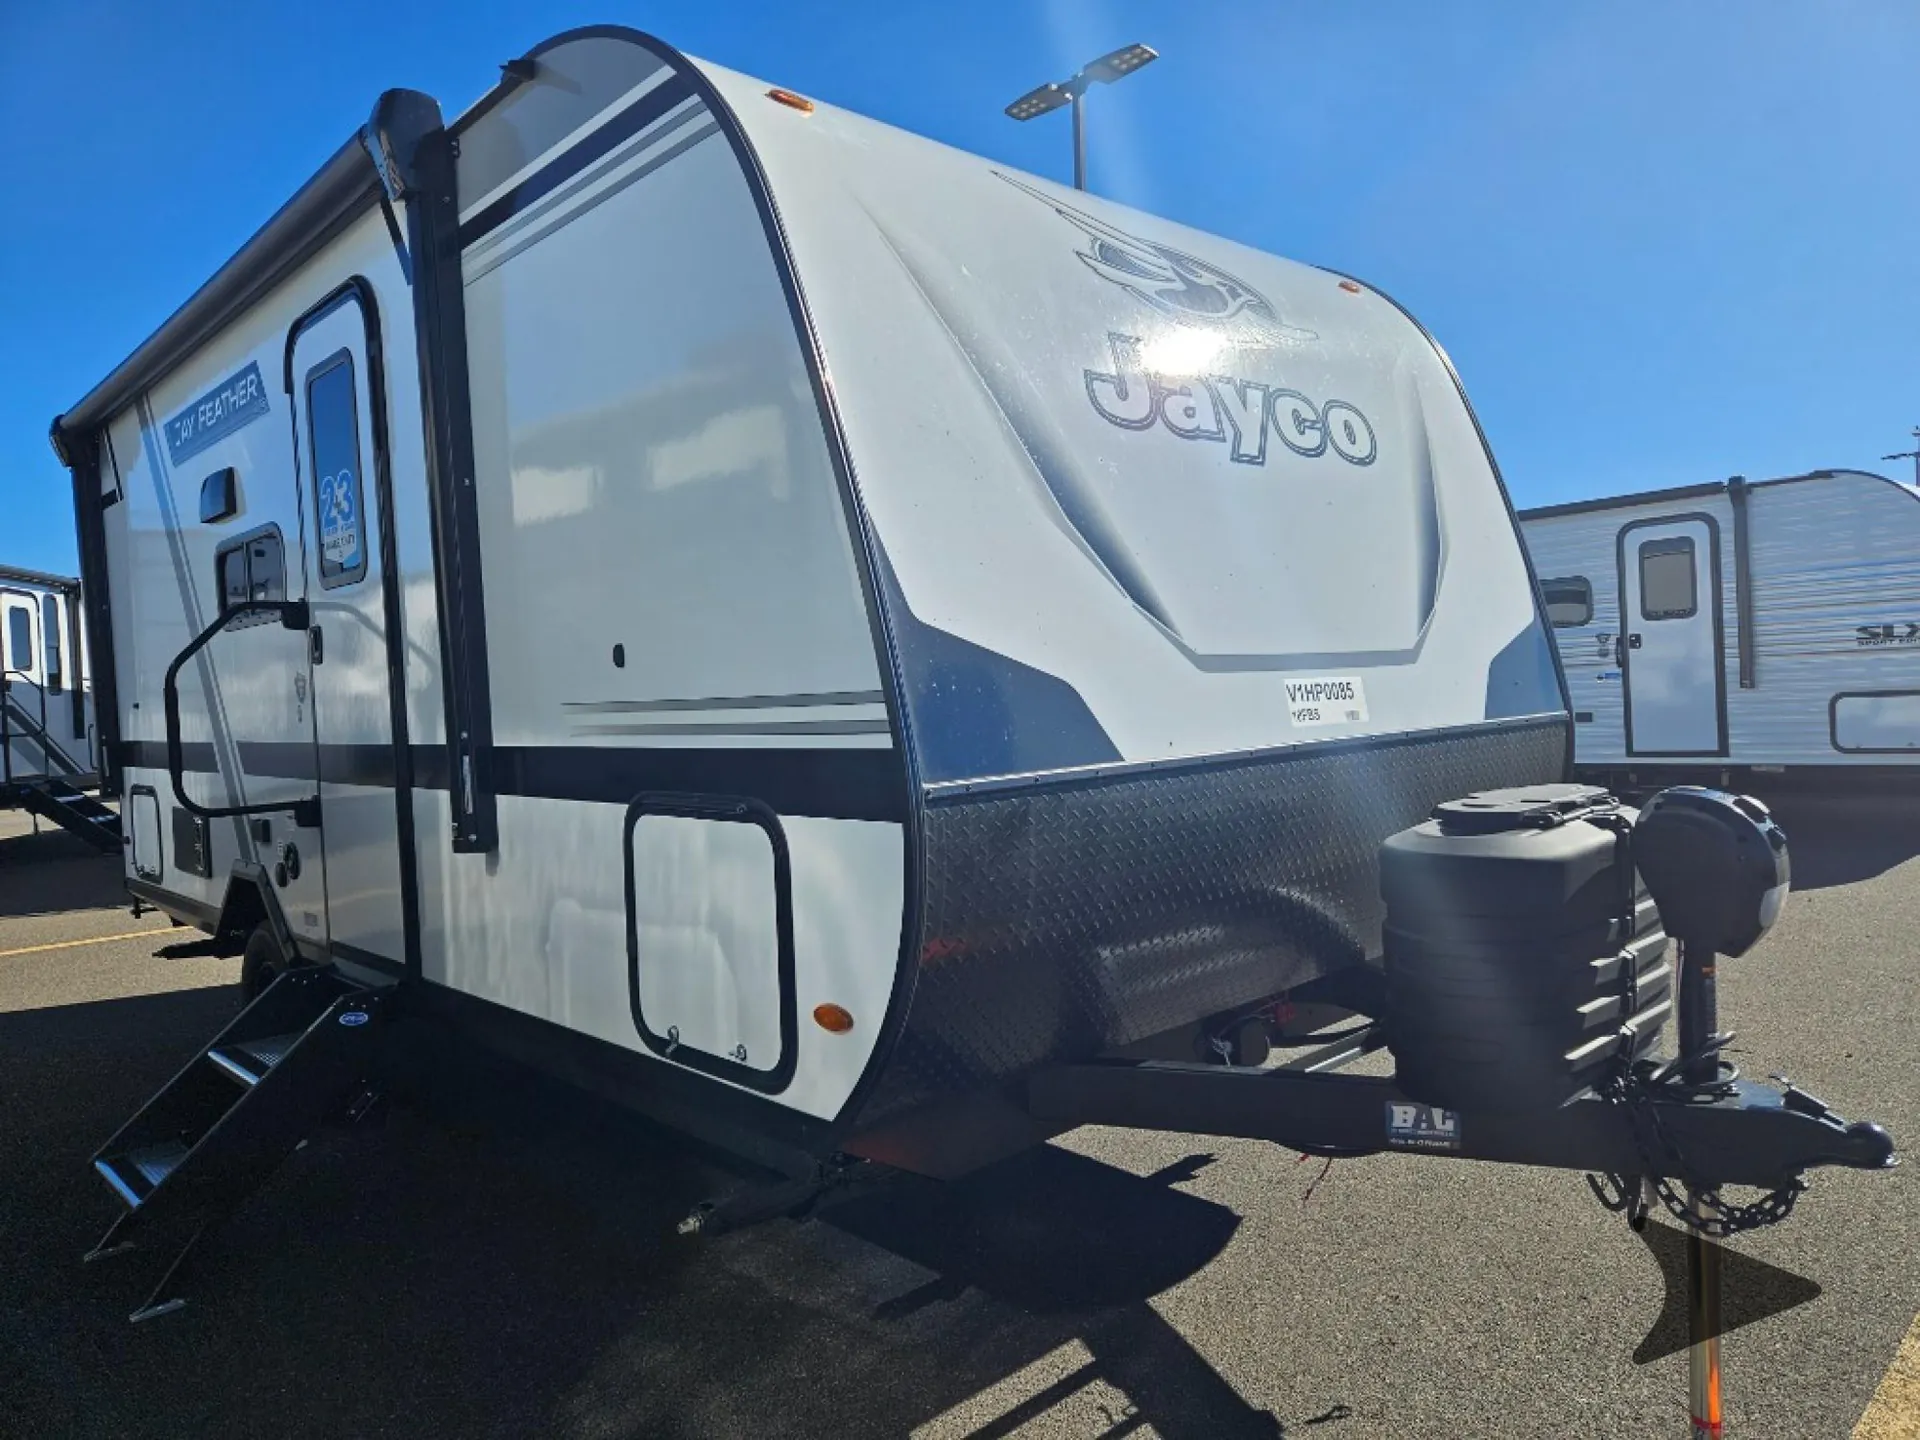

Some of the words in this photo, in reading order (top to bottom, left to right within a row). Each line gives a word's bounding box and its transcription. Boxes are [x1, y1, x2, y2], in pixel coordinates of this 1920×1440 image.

[175, 414, 196, 447] JAY
[198, 372, 258, 430] FEATHER
[1084, 330, 1377, 466] Jayco
[1285, 681, 1355, 702] V1HP0085
[1391, 1105, 1454, 1131] BAL
